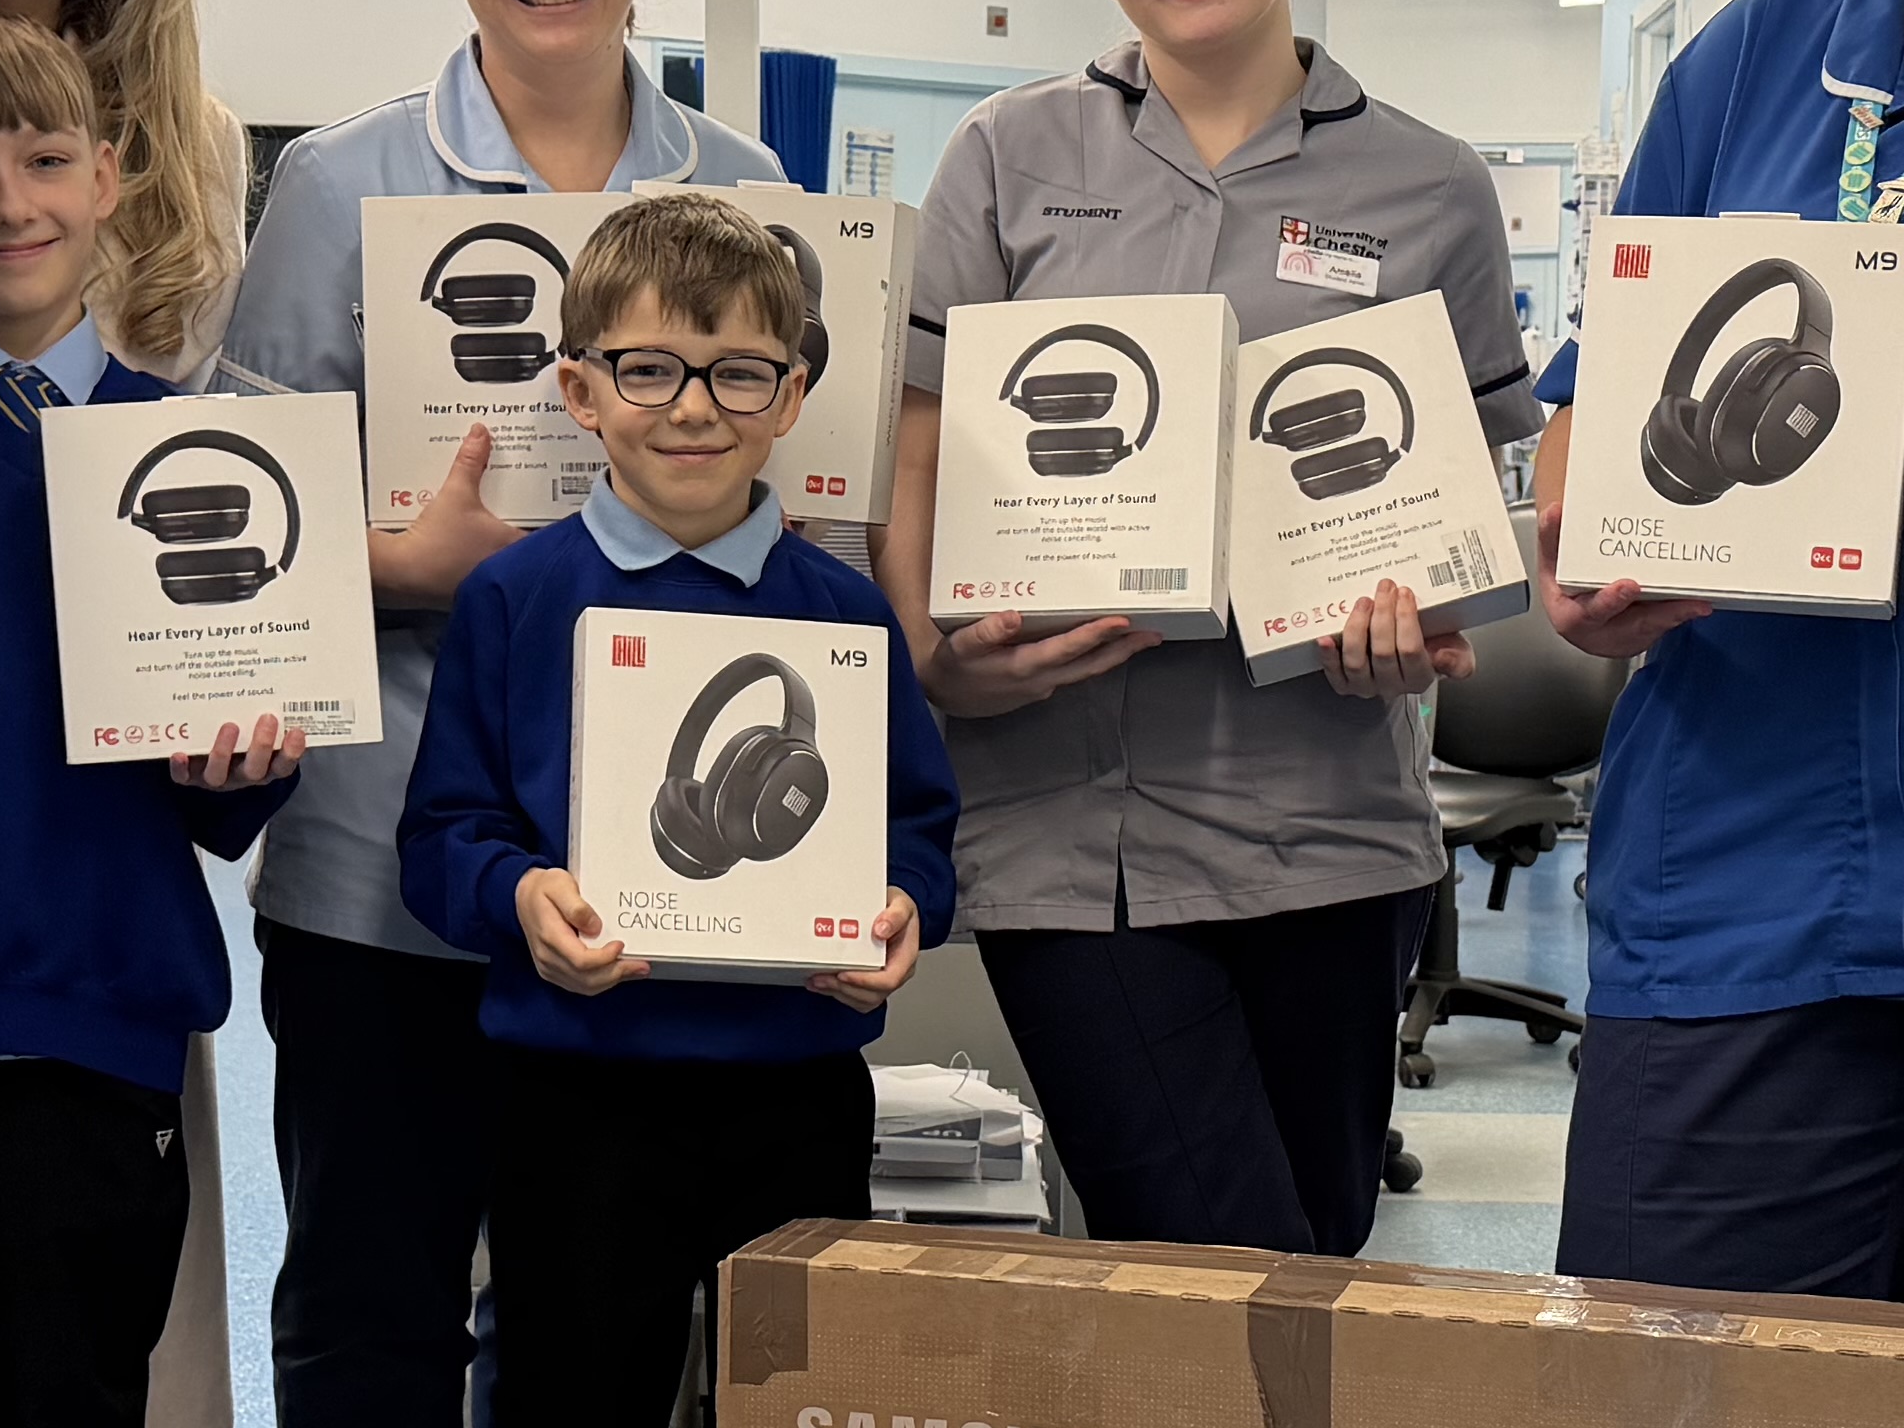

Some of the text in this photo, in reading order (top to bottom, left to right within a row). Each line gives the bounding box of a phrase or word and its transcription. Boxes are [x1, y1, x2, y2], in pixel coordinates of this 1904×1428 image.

[1042, 206, 1122, 220] STUDENT
[839, 219, 874, 240] M9
[1315, 225, 1389, 250] University of
[1313, 236, 1384, 262] Chester
[1854, 250, 1898, 271] M9
[423, 402, 567, 416] Hear Every Layer of Sou
[994, 493, 1157, 508] Hear Every Layer of Sound
[1277, 488, 1440, 541] Hear Every Layer of Sound
[1600, 517, 1665, 538] NOISE
[1599, 537, 1732, 564] CANCELLING
[128, 618, 311, 643] Hear Every Layer of Sound
[830, 648, 868, 668] M9
[618, 890, 679, 911] NOISE
[617, 912, 743, 935] CANCELLING
